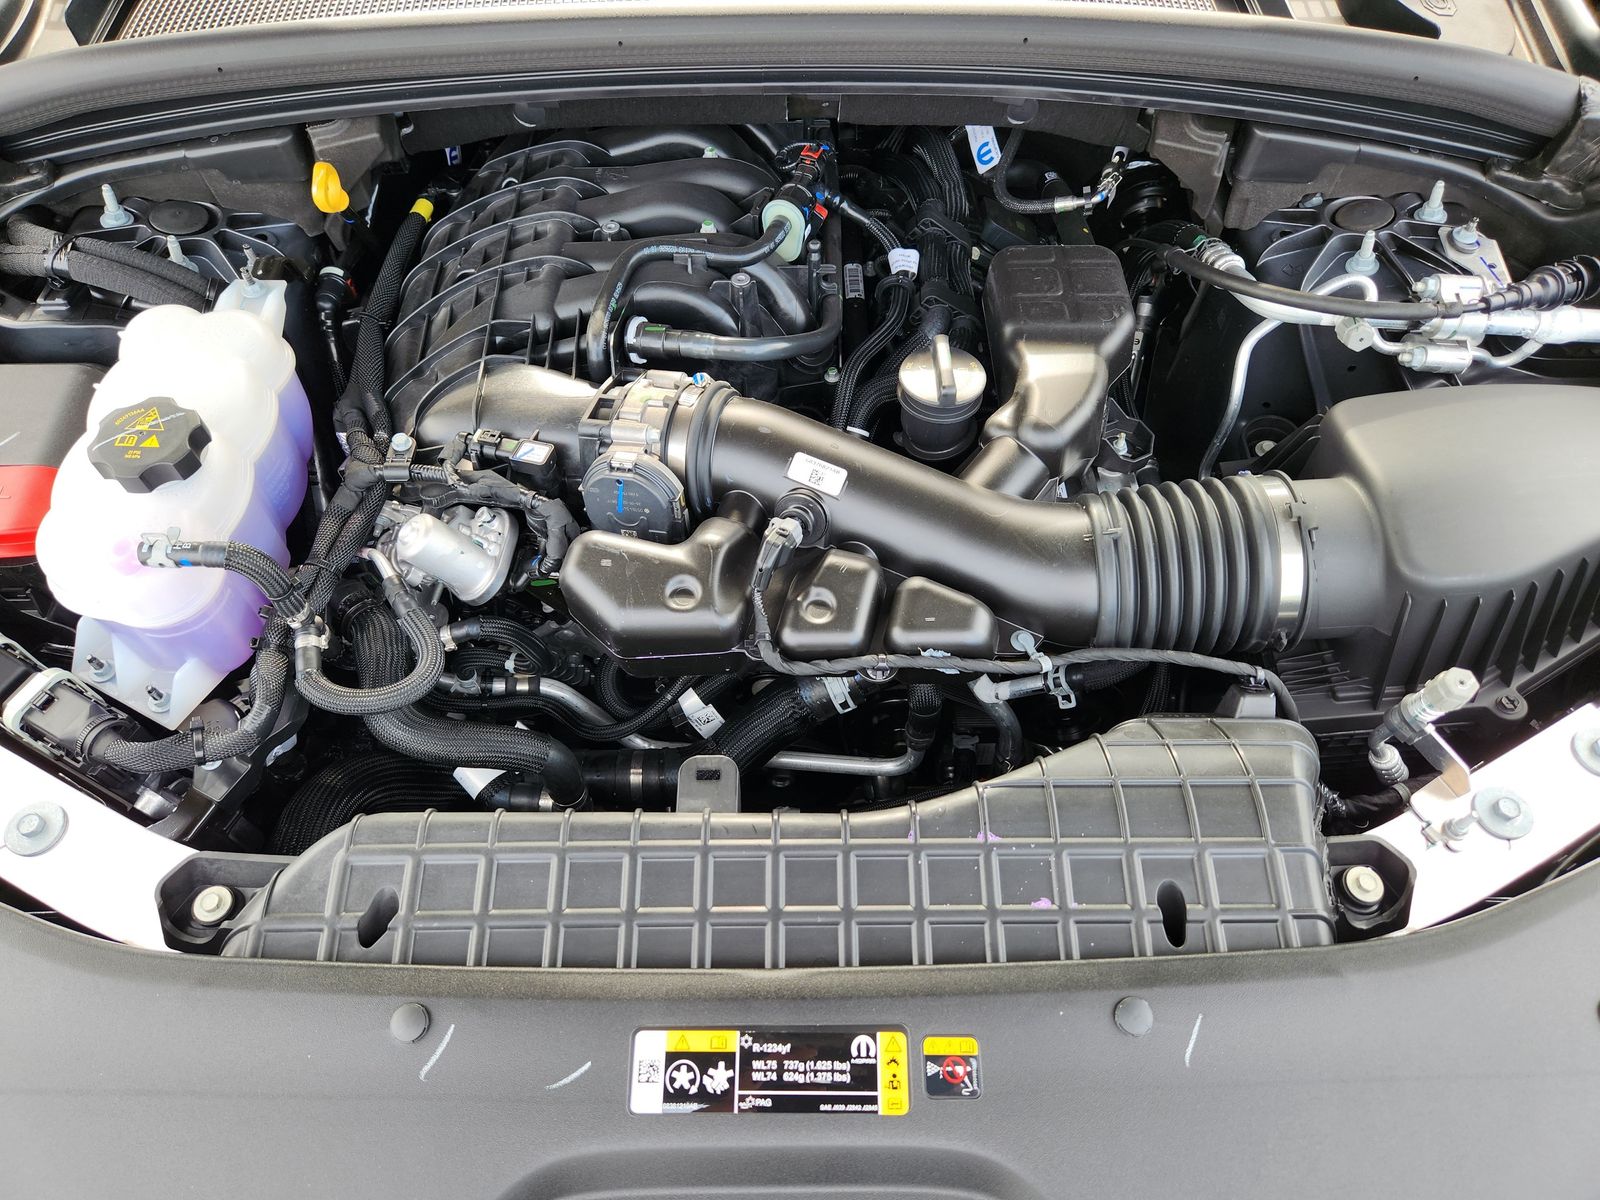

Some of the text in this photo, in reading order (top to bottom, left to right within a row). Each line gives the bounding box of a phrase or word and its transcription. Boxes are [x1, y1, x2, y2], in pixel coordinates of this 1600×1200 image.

[752, 1043, 791, 1055] R-1234yf
[752, 1060, 851, 1072] WL75 737g (1.625 lbs)
[752, 1071, 777, 1081] WL74
[783, 1071, 805, 1084] 624g
[833, 1071, 851, 1083] lbs)
